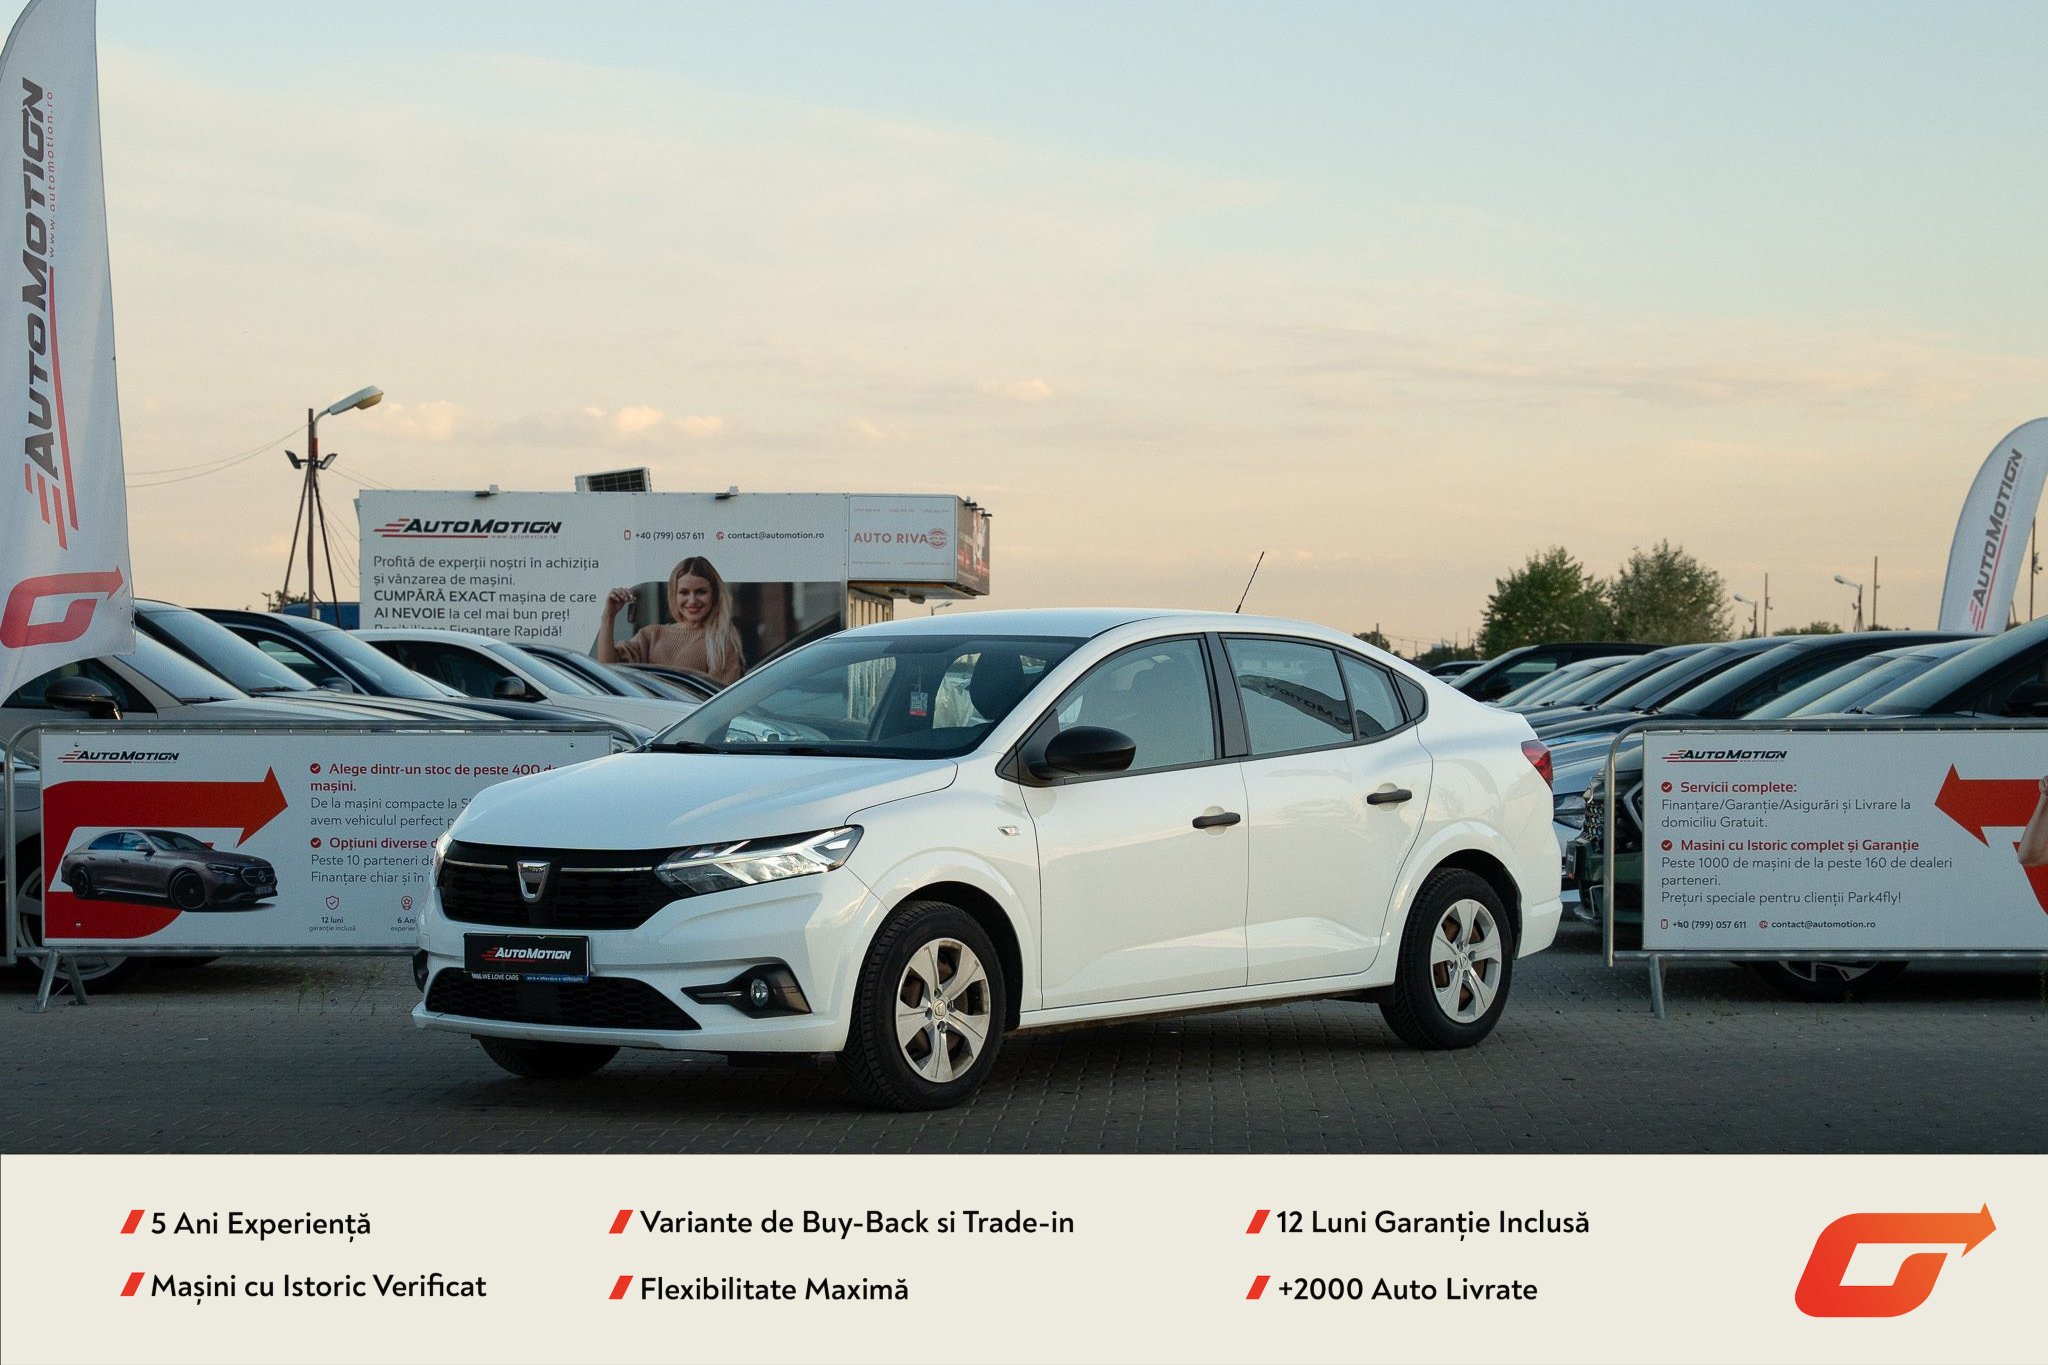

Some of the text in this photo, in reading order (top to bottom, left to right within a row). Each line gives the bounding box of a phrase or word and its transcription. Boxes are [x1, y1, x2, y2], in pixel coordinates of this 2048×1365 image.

[46, 91, 56, 258] www.automotion.ro
[653, 532, 673, 540] (799)
[728, 532, 824, 540] contact@automotion.ro
[854, 533, 928, 543] AUTO RIVA
[419, 557, 435, 567] de
[450, 574, 465, 585] de
[374, 587, 445, 602] CUMPĂRĂ
[450, 588, 496, 602] EXACT
[550, 591, 565, 602] de
[570, 594, 596, 602] care
[374, 607, 388, 618] AI
[392, 607, 445, 619] NEVOIE
[450, 608, 459, 619] la
[464, 609, 481, 619] cel
[486, 608, 508, 619] mai
[514, 609, 537, 619] bun
[514, 625, 562, 639] Rapidă!
[329, 764, 367, 777] Alege
[371, 764, 421, 775] dintr-un
[425, 765, 451, 775] stoc
[455, 764, 470, 775] de
[474, 765, 509, 777] peste
[512, 764, 540, 775] 400
[1681, 782, 1796, 795] Servicii complete:
[311, 798, 328, 808] De
[332, 797, 340, 808] la
[385, 800, 444, 811] compacte
[448, 798, 457, 809] la
[1856, 799, 1897, 810] Livrare
[1901, 798, 1910, 809] la
[311, 815, 341, 825] avem
[345, 814, 396, 825] vehiculul
[401, 814, 444, 828] perfect
[1662, 816, 1767, 827] domiciliu Gratuit.
[381, 838, 427, 848] diverse
[1682, 840, 1724, 850] Masini
[1748, 840, 1787, 850] Istoric
[1791, 840, 1844, 853] complet
[311, 855, 343, 866] Peste
[347, 855, 359, 866] 10
[363, 855, 418, 869] parteneri
[1662, 857, 1695, 868] Peste
[1699, 857, 1729, 869] 1000
[1733, 857, 1748, 868] de
[1795, 857, 1810, 868] de
[1814, 857, 1823, 868] la
[1828, 859, 1862, 871] peste
[1865, 857, 1886, 868] 160
[1891, 857, 1906, 868] de
[1910, 856, 1952, 868] dealeri
[370, 872, 399, 883] chiar
[1662, 875, 1720, 887] parteneri.
[1706, 891, 1755, 905] speciale
[1760, 893, 1800, 905] pentru
[1849, 891, 1901, 905] Park4fly!
[1692, 920, 1713, 930] (799)
[1772, 920, 1875, 929] contact@automotion.ro
